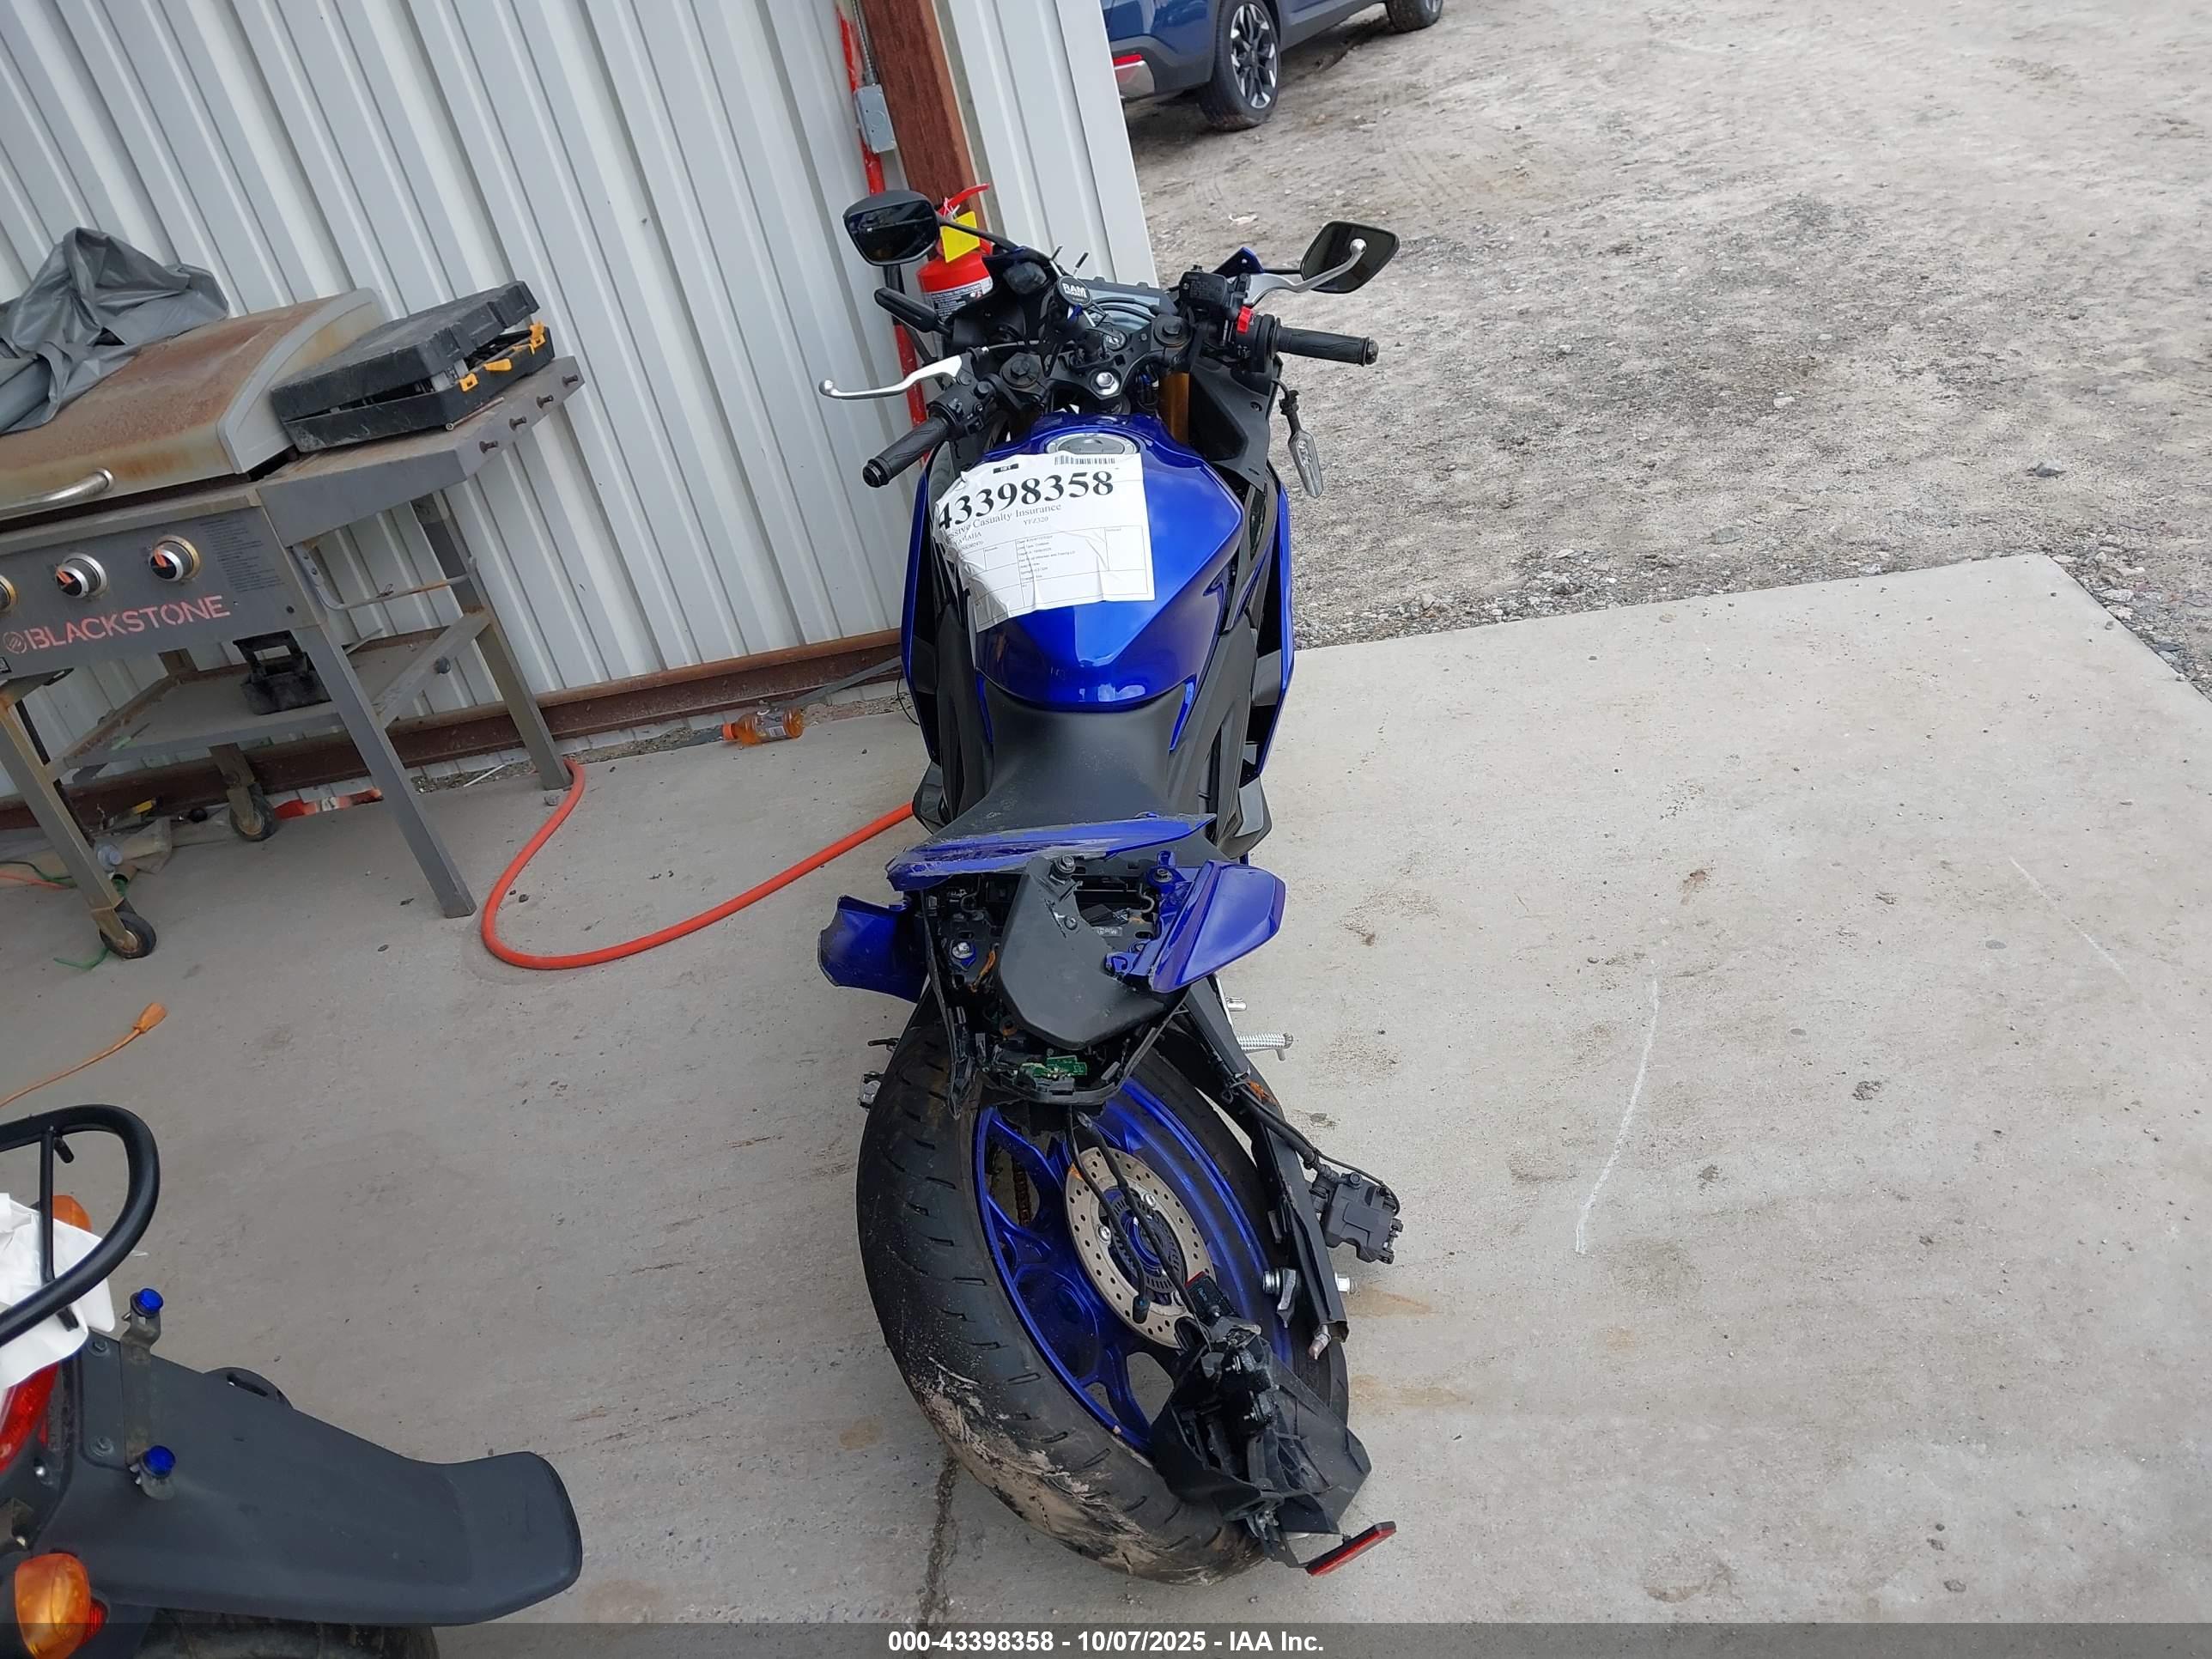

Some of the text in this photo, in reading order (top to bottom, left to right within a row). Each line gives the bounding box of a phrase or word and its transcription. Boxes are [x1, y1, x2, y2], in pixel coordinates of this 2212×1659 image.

[939, 471, 1114, 530] 43398358
[973, 513, 1012, 528] Casualty
[1016, 504, 1061, 518] Insurance
[24, 595, 231, 650] BLACKSTONE
